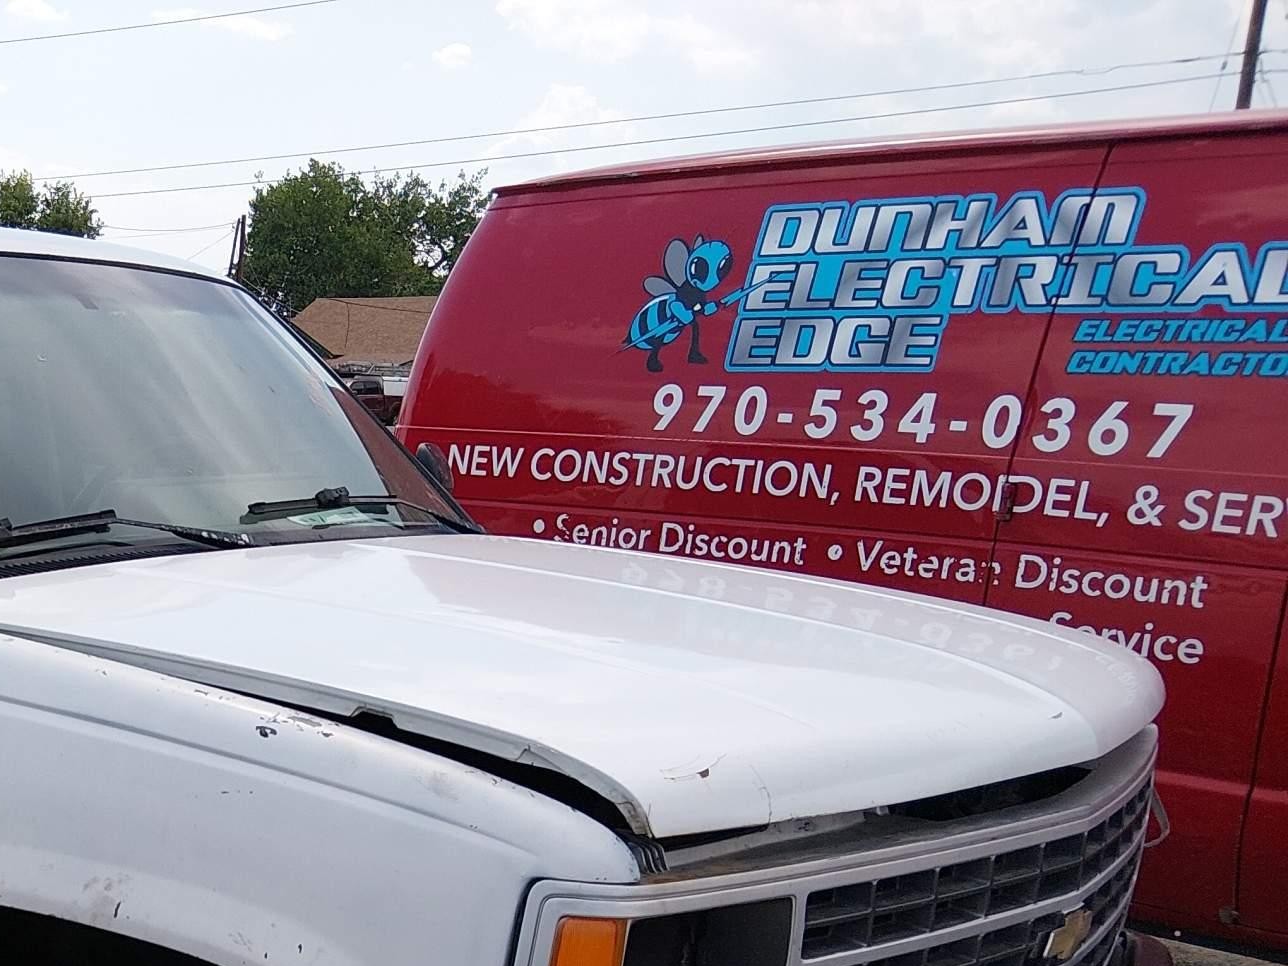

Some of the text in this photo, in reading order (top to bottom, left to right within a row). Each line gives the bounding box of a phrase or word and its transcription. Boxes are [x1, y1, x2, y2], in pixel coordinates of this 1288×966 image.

[760, 194, 1138, 256] DUNHAM
[745, 250, 1288, 310] ELECTRICAL
[730, 316, 941, 365] EDGE
[1073, 319, 1288, 343] ELECTRICAL
[652, 383, 1195, 459] 970-534-0367
[447, 443, 1288, 538] NEW CONSTRUCTION, REMODEL, & SER
[553, 513, 652, 550] Senior
[659, 521, 807, 566] Discount
[1015, 553, 1209, 608] Discount
